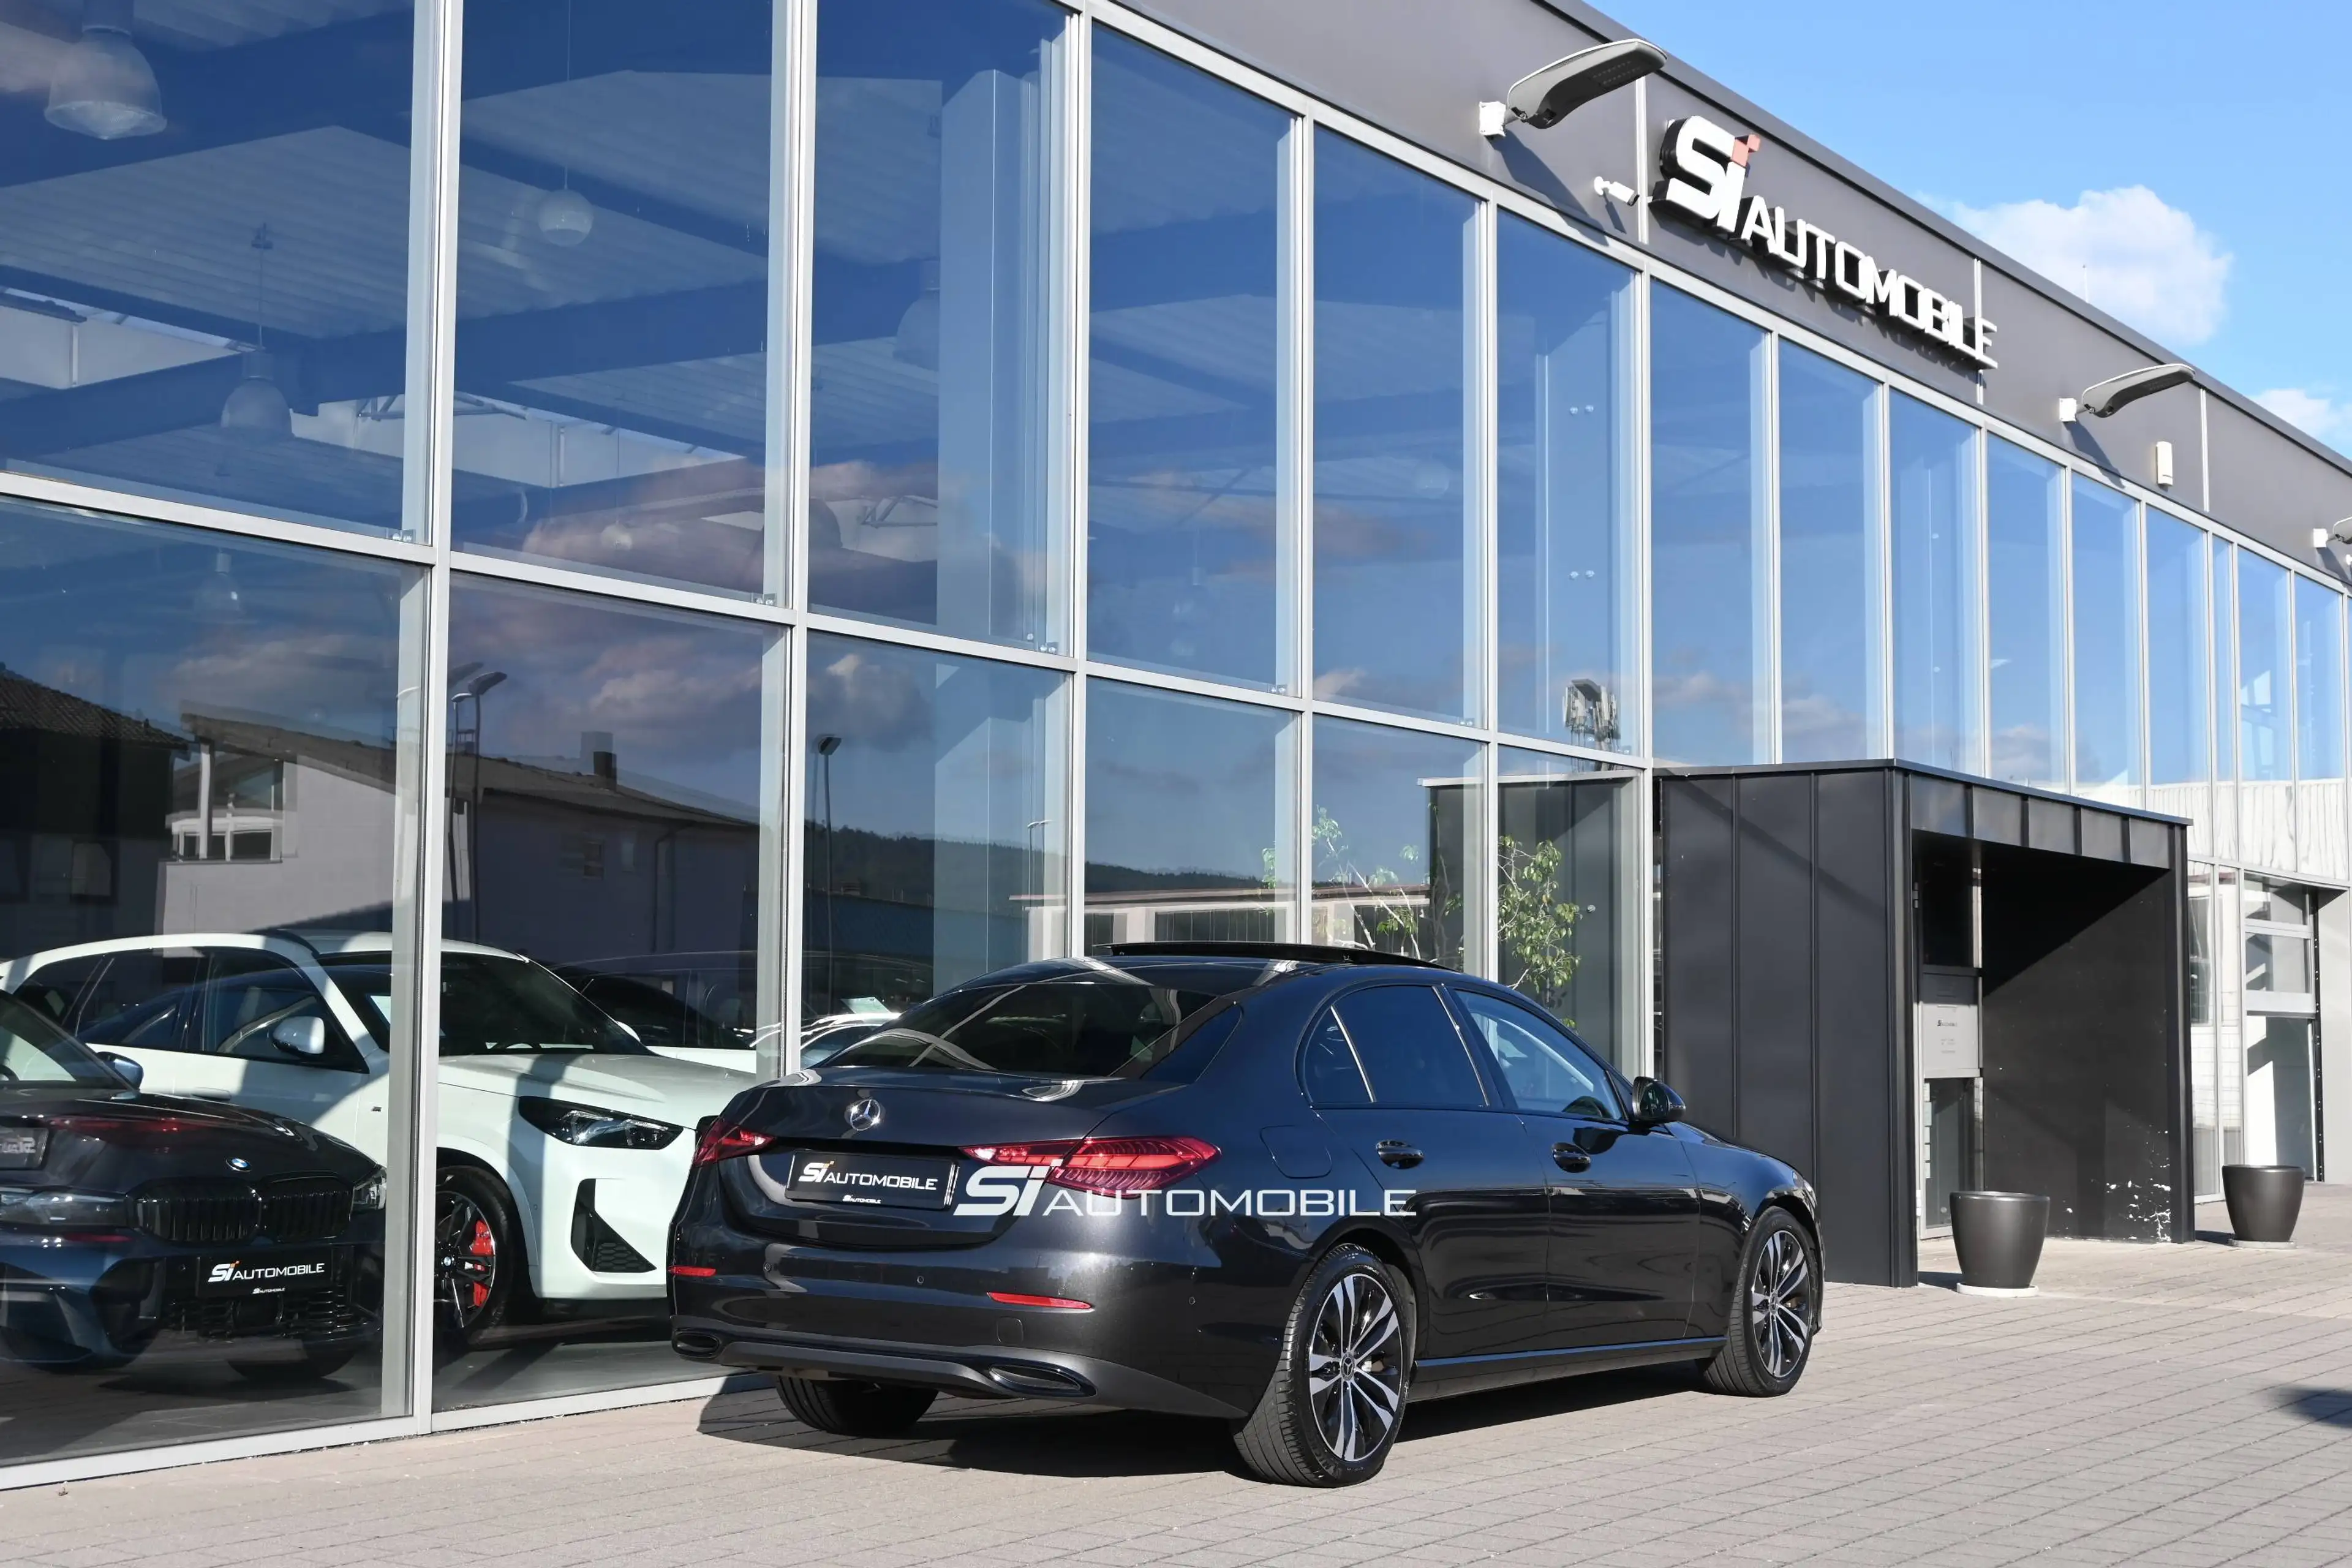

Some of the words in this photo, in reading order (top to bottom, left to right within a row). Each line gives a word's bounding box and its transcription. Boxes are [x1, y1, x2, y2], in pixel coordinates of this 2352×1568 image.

[1741, 195, 1999, 369] AUTOMOBILE
[823, 1172, 938, 1191] AUTOMOBILE
[232, 1263, 325, 1281] AUTOMOBILE
